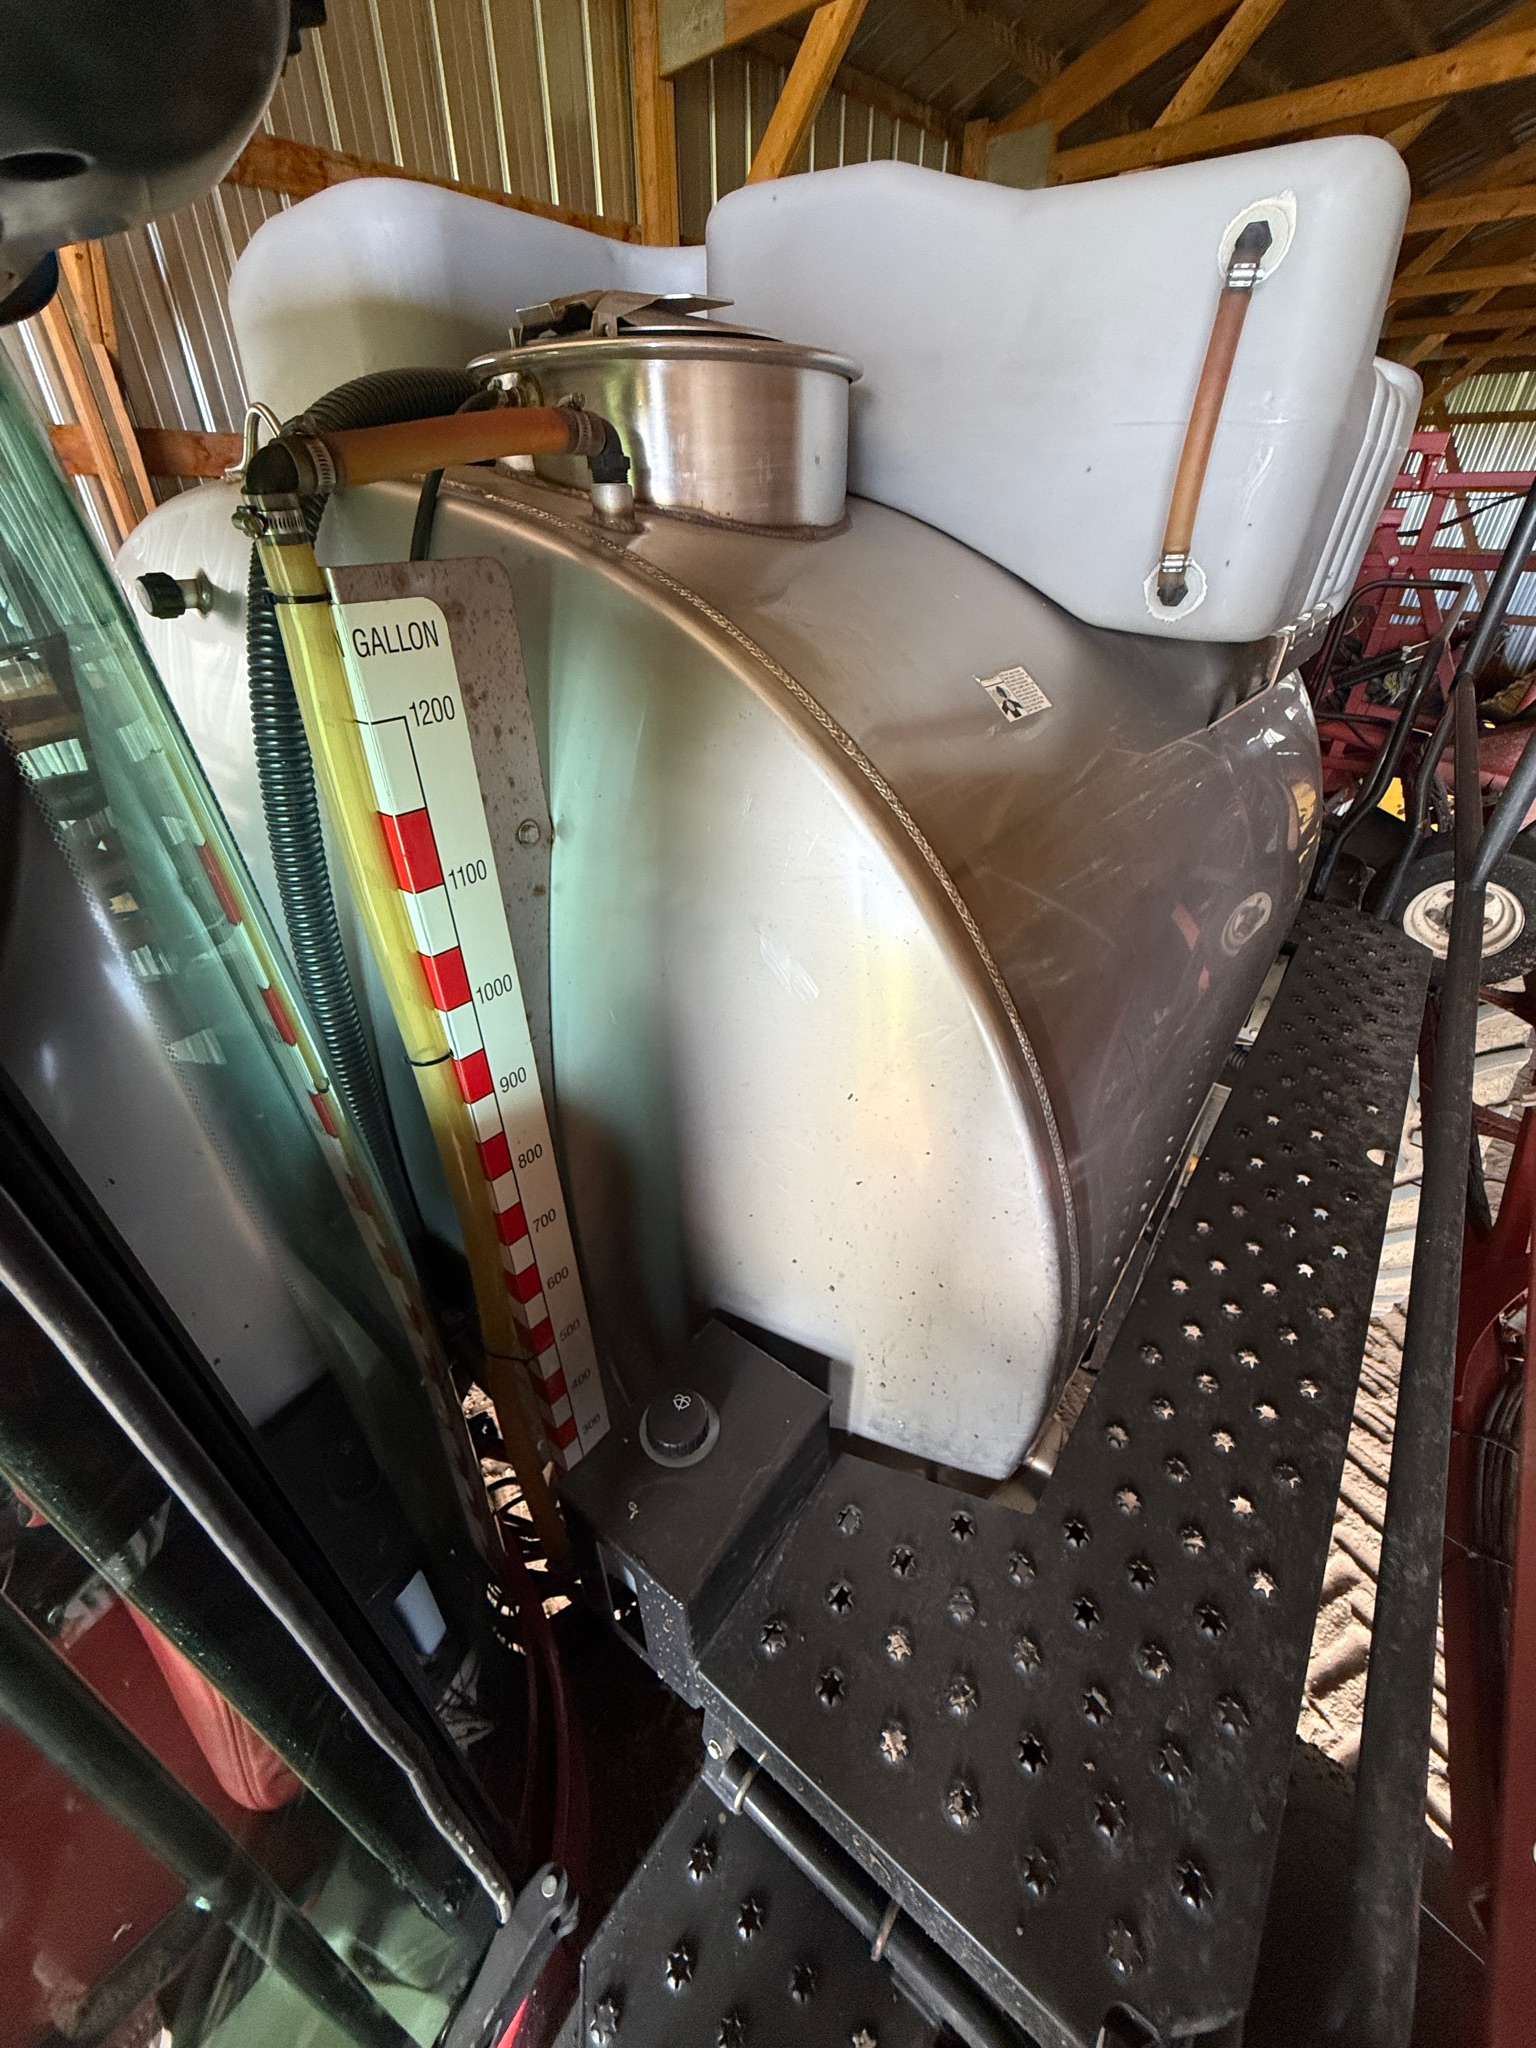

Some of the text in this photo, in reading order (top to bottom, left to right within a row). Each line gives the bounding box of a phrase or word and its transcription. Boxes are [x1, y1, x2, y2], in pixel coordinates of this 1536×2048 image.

[352, 620, 440, 658] GALLON
[409, 695, 456, 727] 1200
[448, 859, 488, 890] 1100
[475, 974, 513, 1004] 1000
[499, 1066, 527, 1093] 900
[517, 1143, 543, 1169] 800
[532, 1208, 557, 1234] 700
[546, 1266, 569, 1290] 600
[558, 1319, 581, 1342] 500
